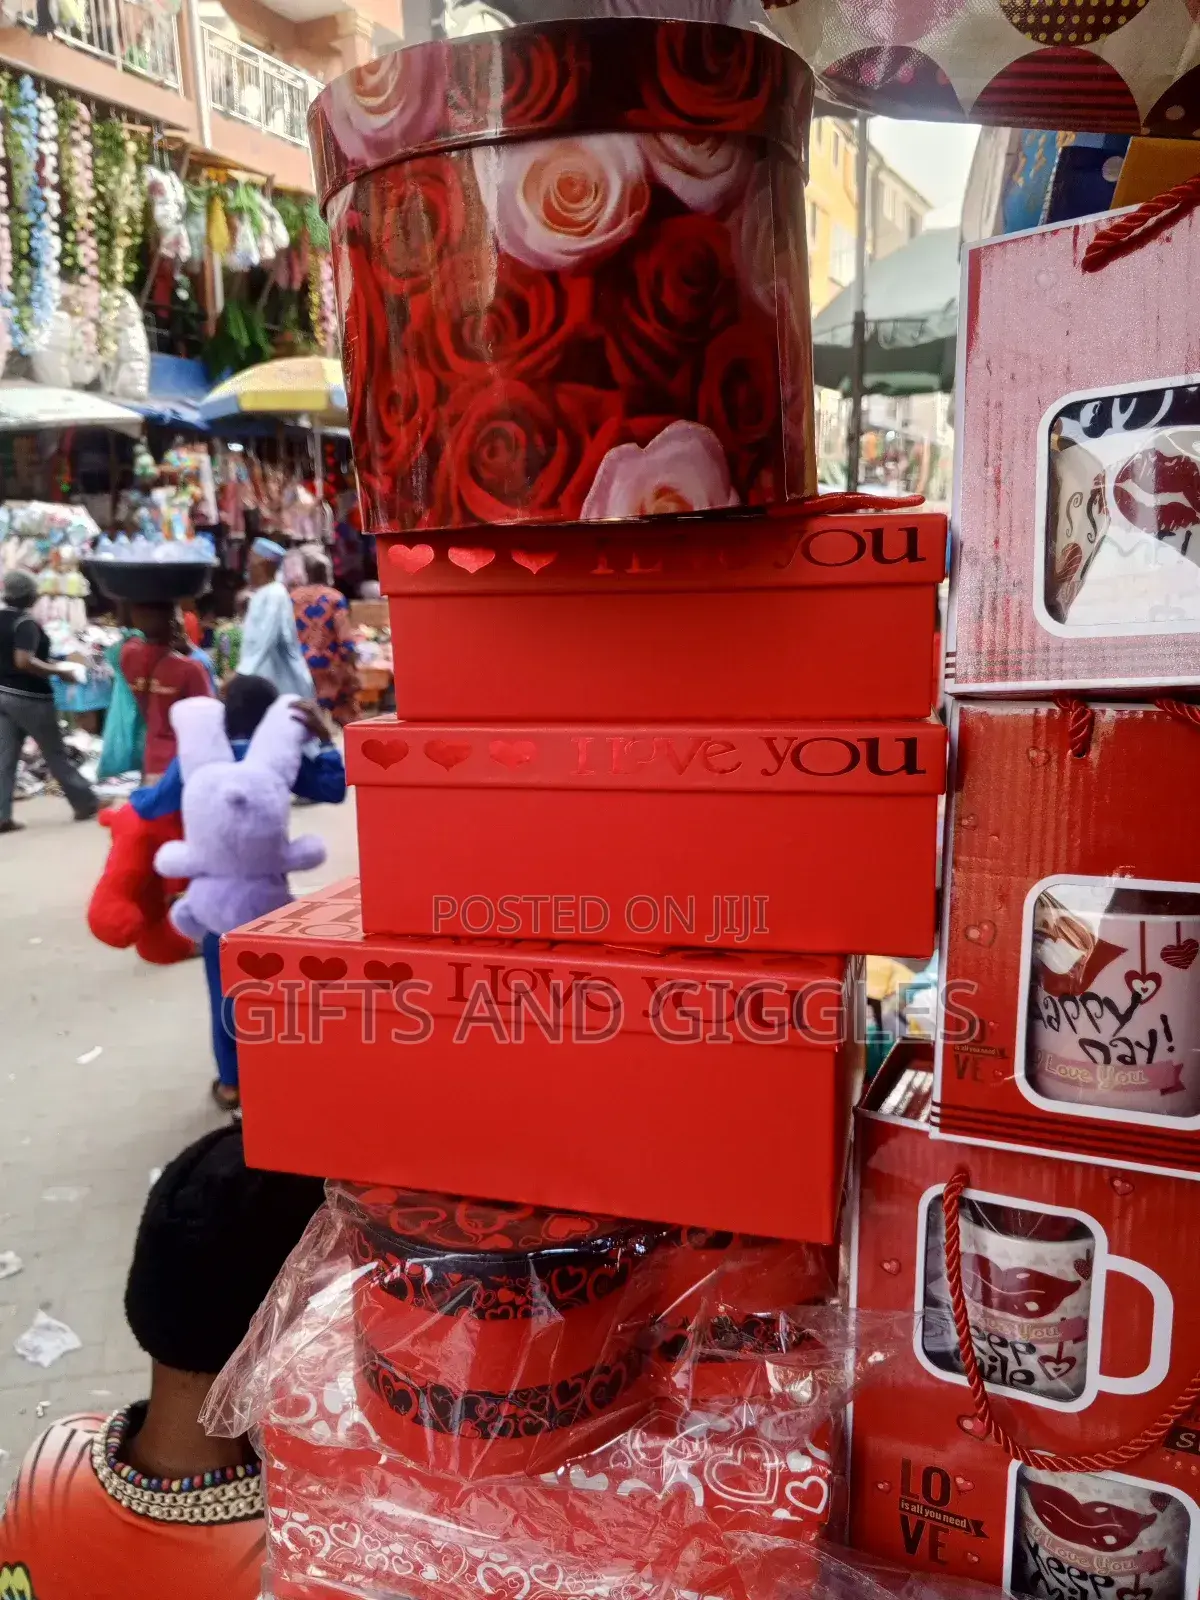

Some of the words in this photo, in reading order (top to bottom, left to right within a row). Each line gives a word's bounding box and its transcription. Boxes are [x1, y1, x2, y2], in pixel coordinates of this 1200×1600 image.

[760, 736, 927, 777] you
[641, 975, 814, 1031] you
[1044, 1053, 1093, 1084] Love
[1094, 1063, 1149, 1092] You
[971, 1325, 1037, 1367] eep
[901, 1500, 910, 1511] is
[910, 1503, 923, 1516] all
[924, 1508, 941, 1521] you
[942, 1513, 968, 1529] need
[1045, 1536, 1092, 1569] Love
[1093, 1552, 1139, 1576] You
